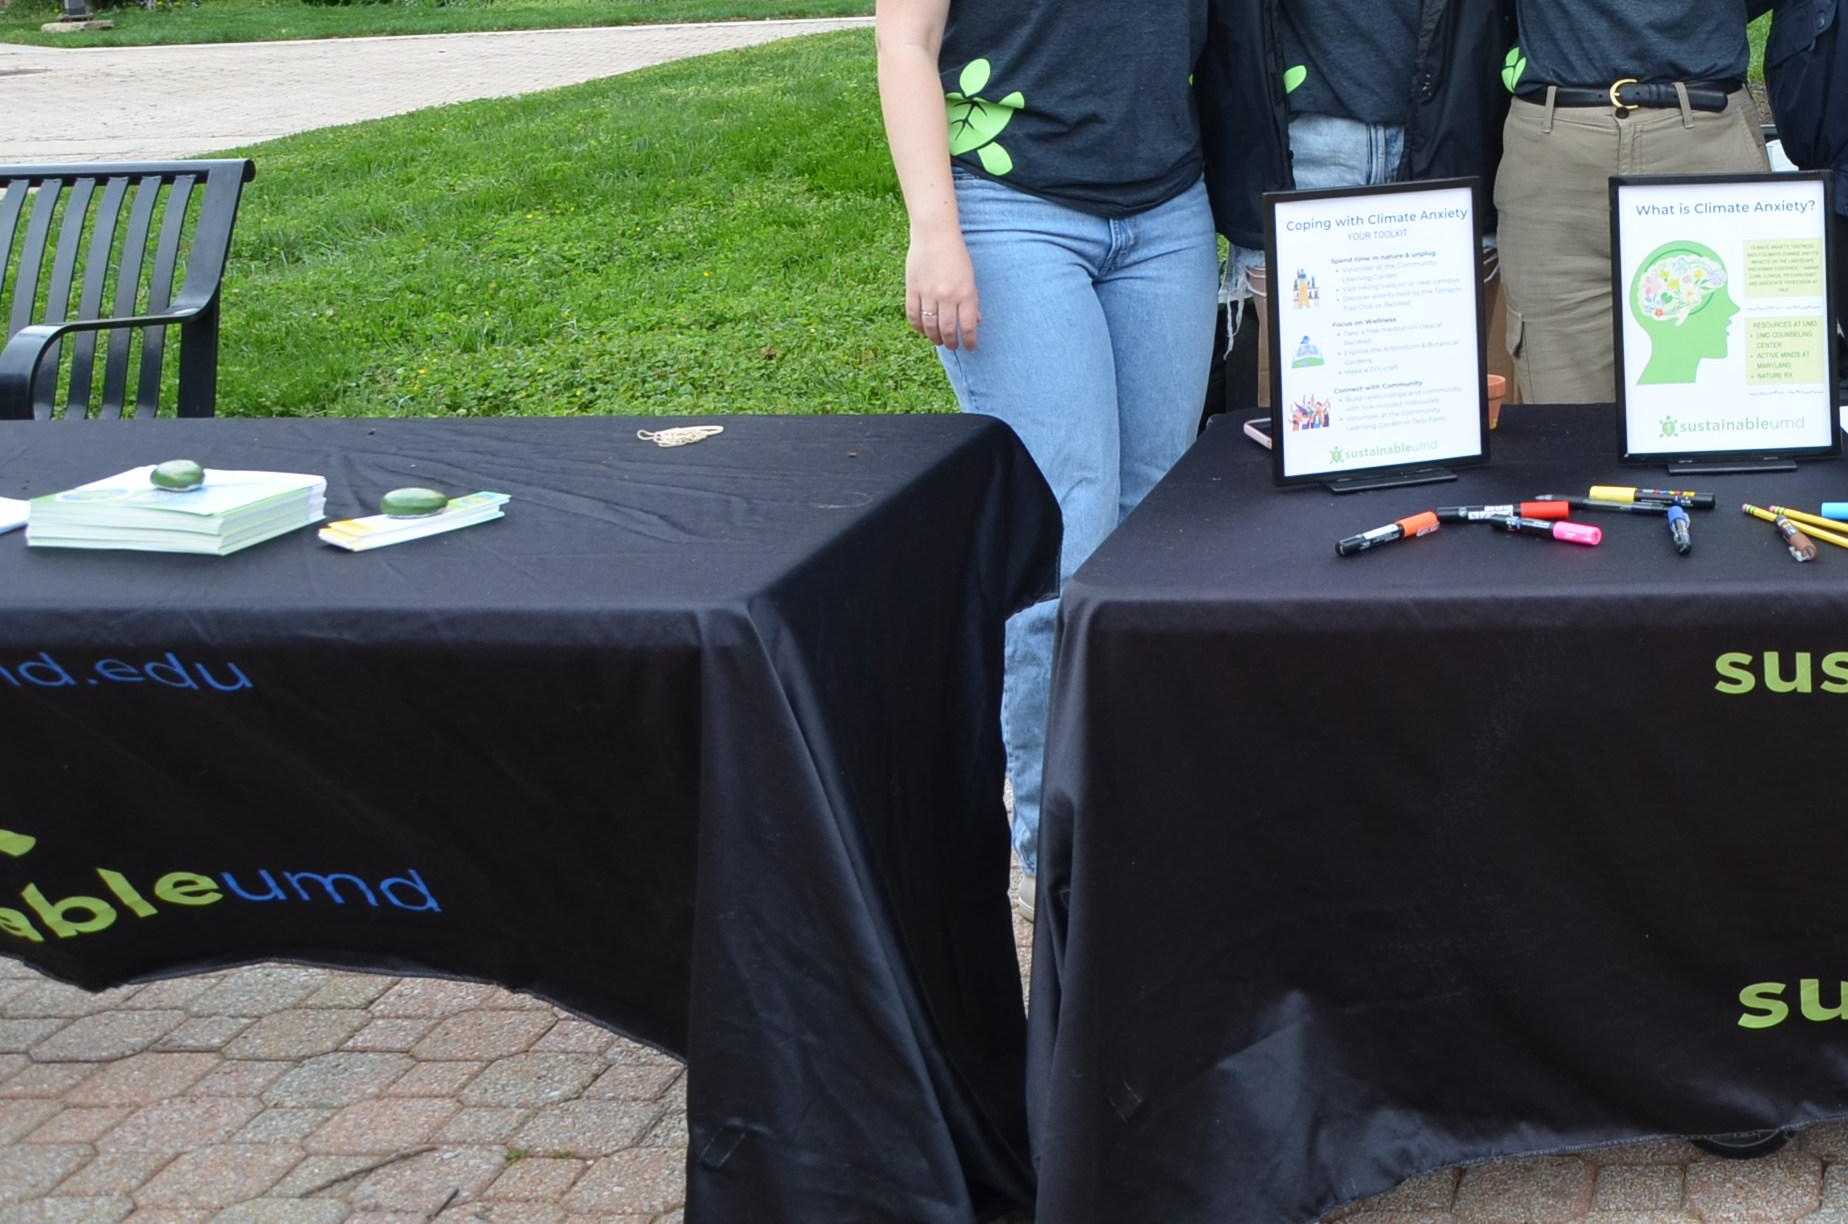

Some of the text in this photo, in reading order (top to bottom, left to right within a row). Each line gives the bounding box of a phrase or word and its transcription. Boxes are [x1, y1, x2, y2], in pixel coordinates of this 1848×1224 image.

[1635, 199, 1816, 216] What is Climate Anxiety?
[1286, 207, 1468, 233] Coping with Climate Anxiety
[1347, 228, 1407, 241] YOUR TOOLKIT
[1382, 380, 1423, 389] Community
[1680, 416, 1805, 433] sustainableumd
[1345, 440, 1438, 459] sustainableumd
[0, 652, 253, 691] d.edu
